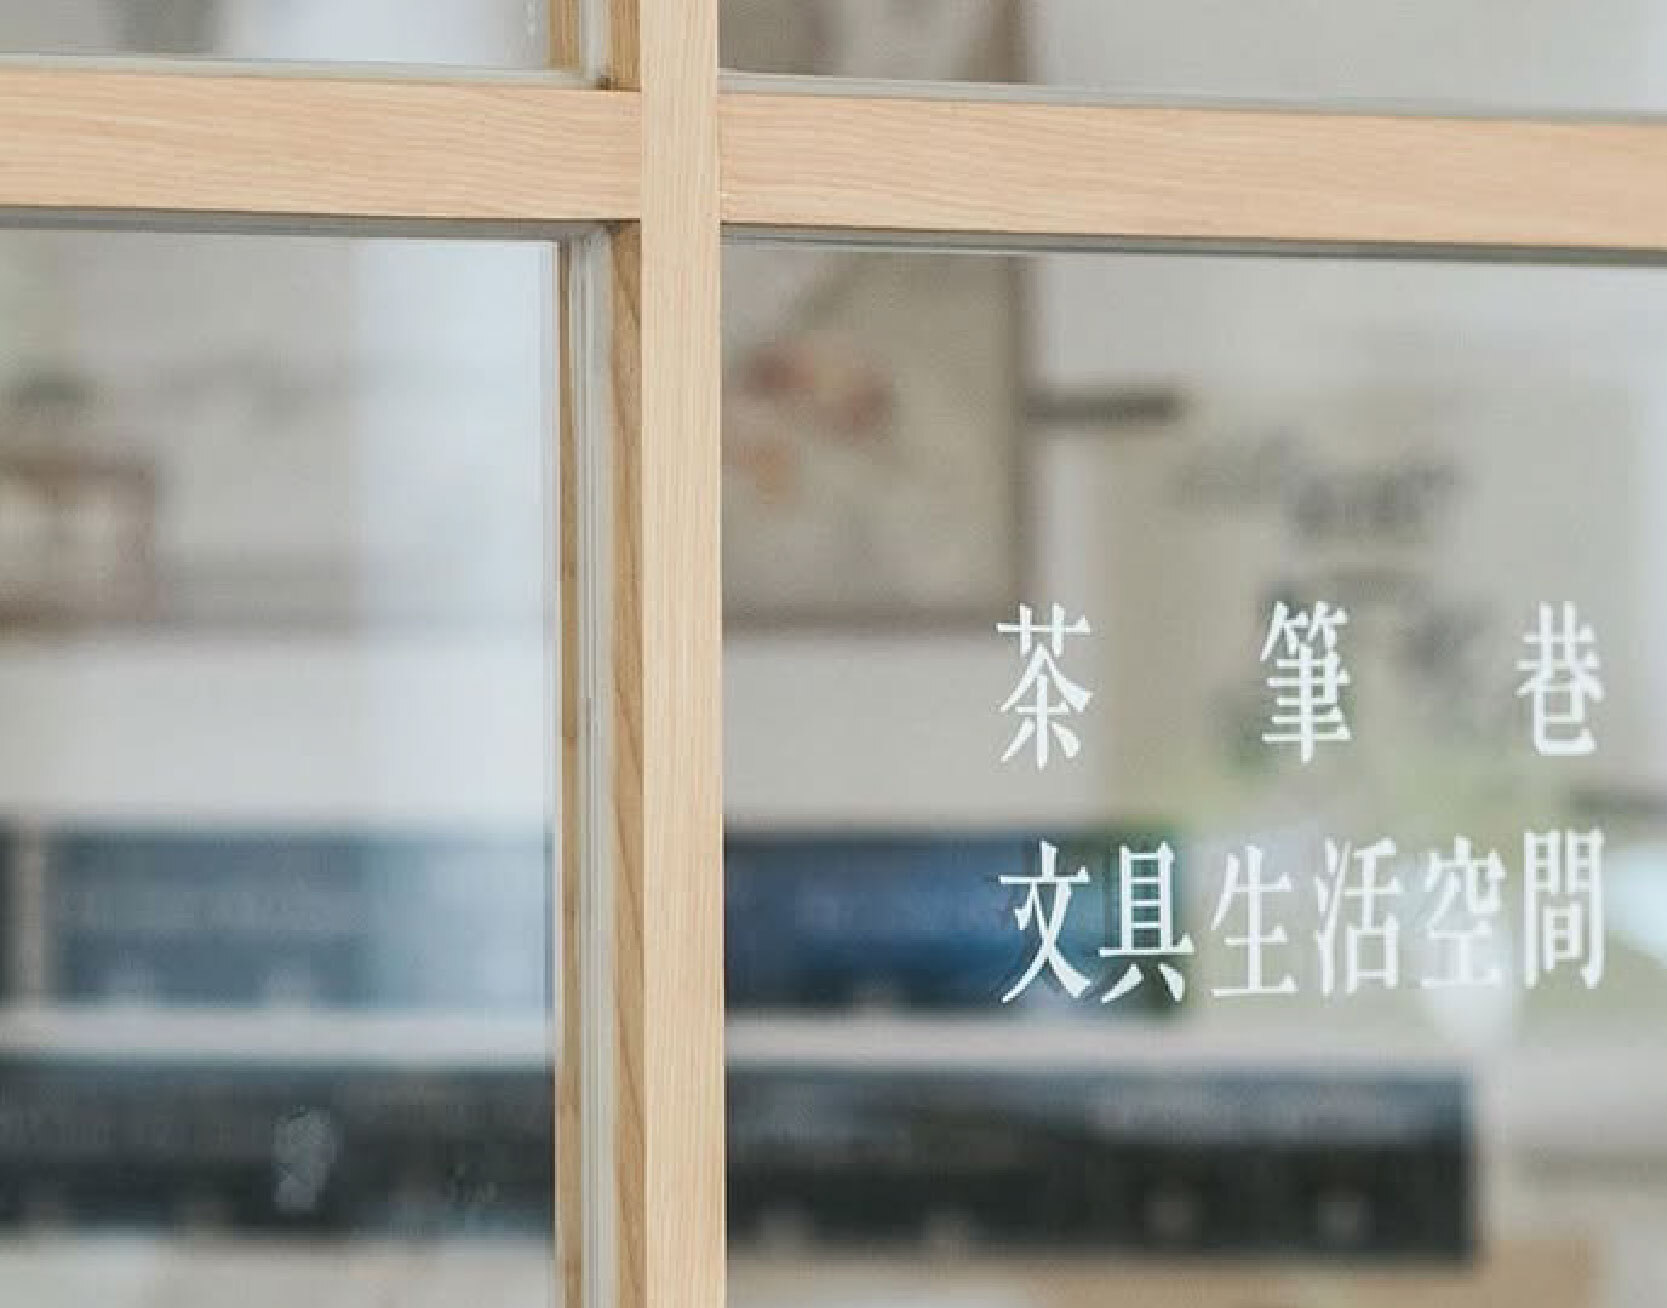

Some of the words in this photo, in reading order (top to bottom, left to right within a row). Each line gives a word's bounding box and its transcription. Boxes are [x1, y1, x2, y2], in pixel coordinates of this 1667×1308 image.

[996, 601, 1605, 769] 茶筆巷
[999, 828, 1605, 1003] 文具生活空間
